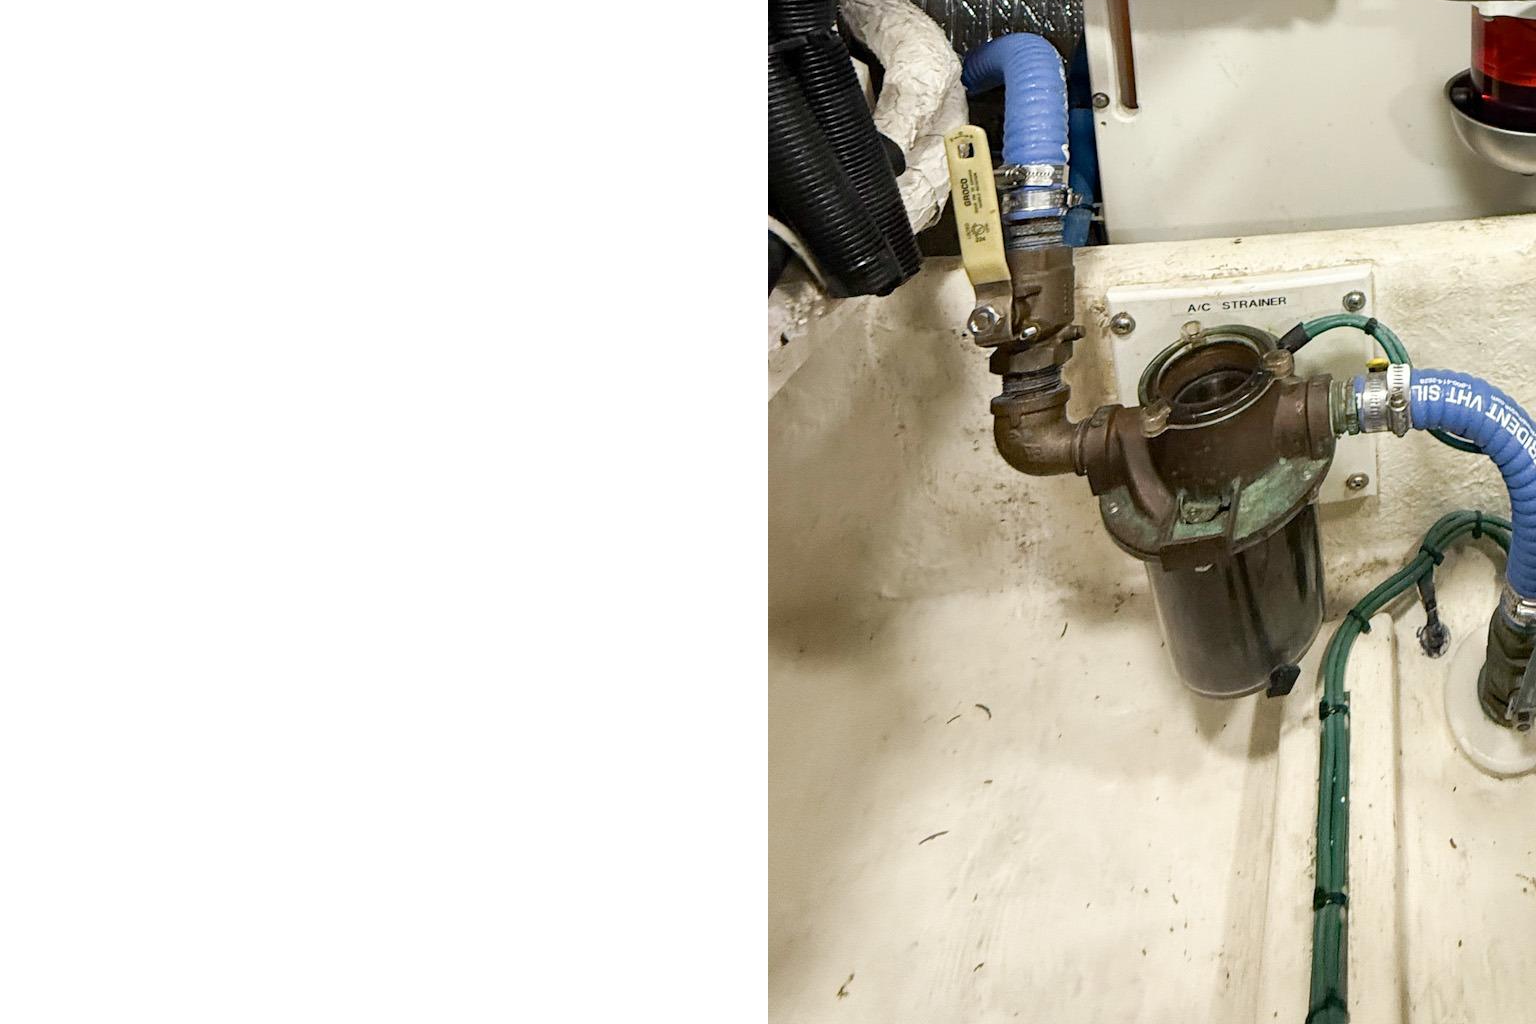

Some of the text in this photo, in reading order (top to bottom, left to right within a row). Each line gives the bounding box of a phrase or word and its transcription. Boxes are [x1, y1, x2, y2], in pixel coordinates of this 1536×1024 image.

[960, 178, 972, 207] GROCO
[1187, 296, 1287, 313] A/C STRAINER
[1411, 384, 1441, 402] SIL
[1445, 385, 1483, 412] VHT
